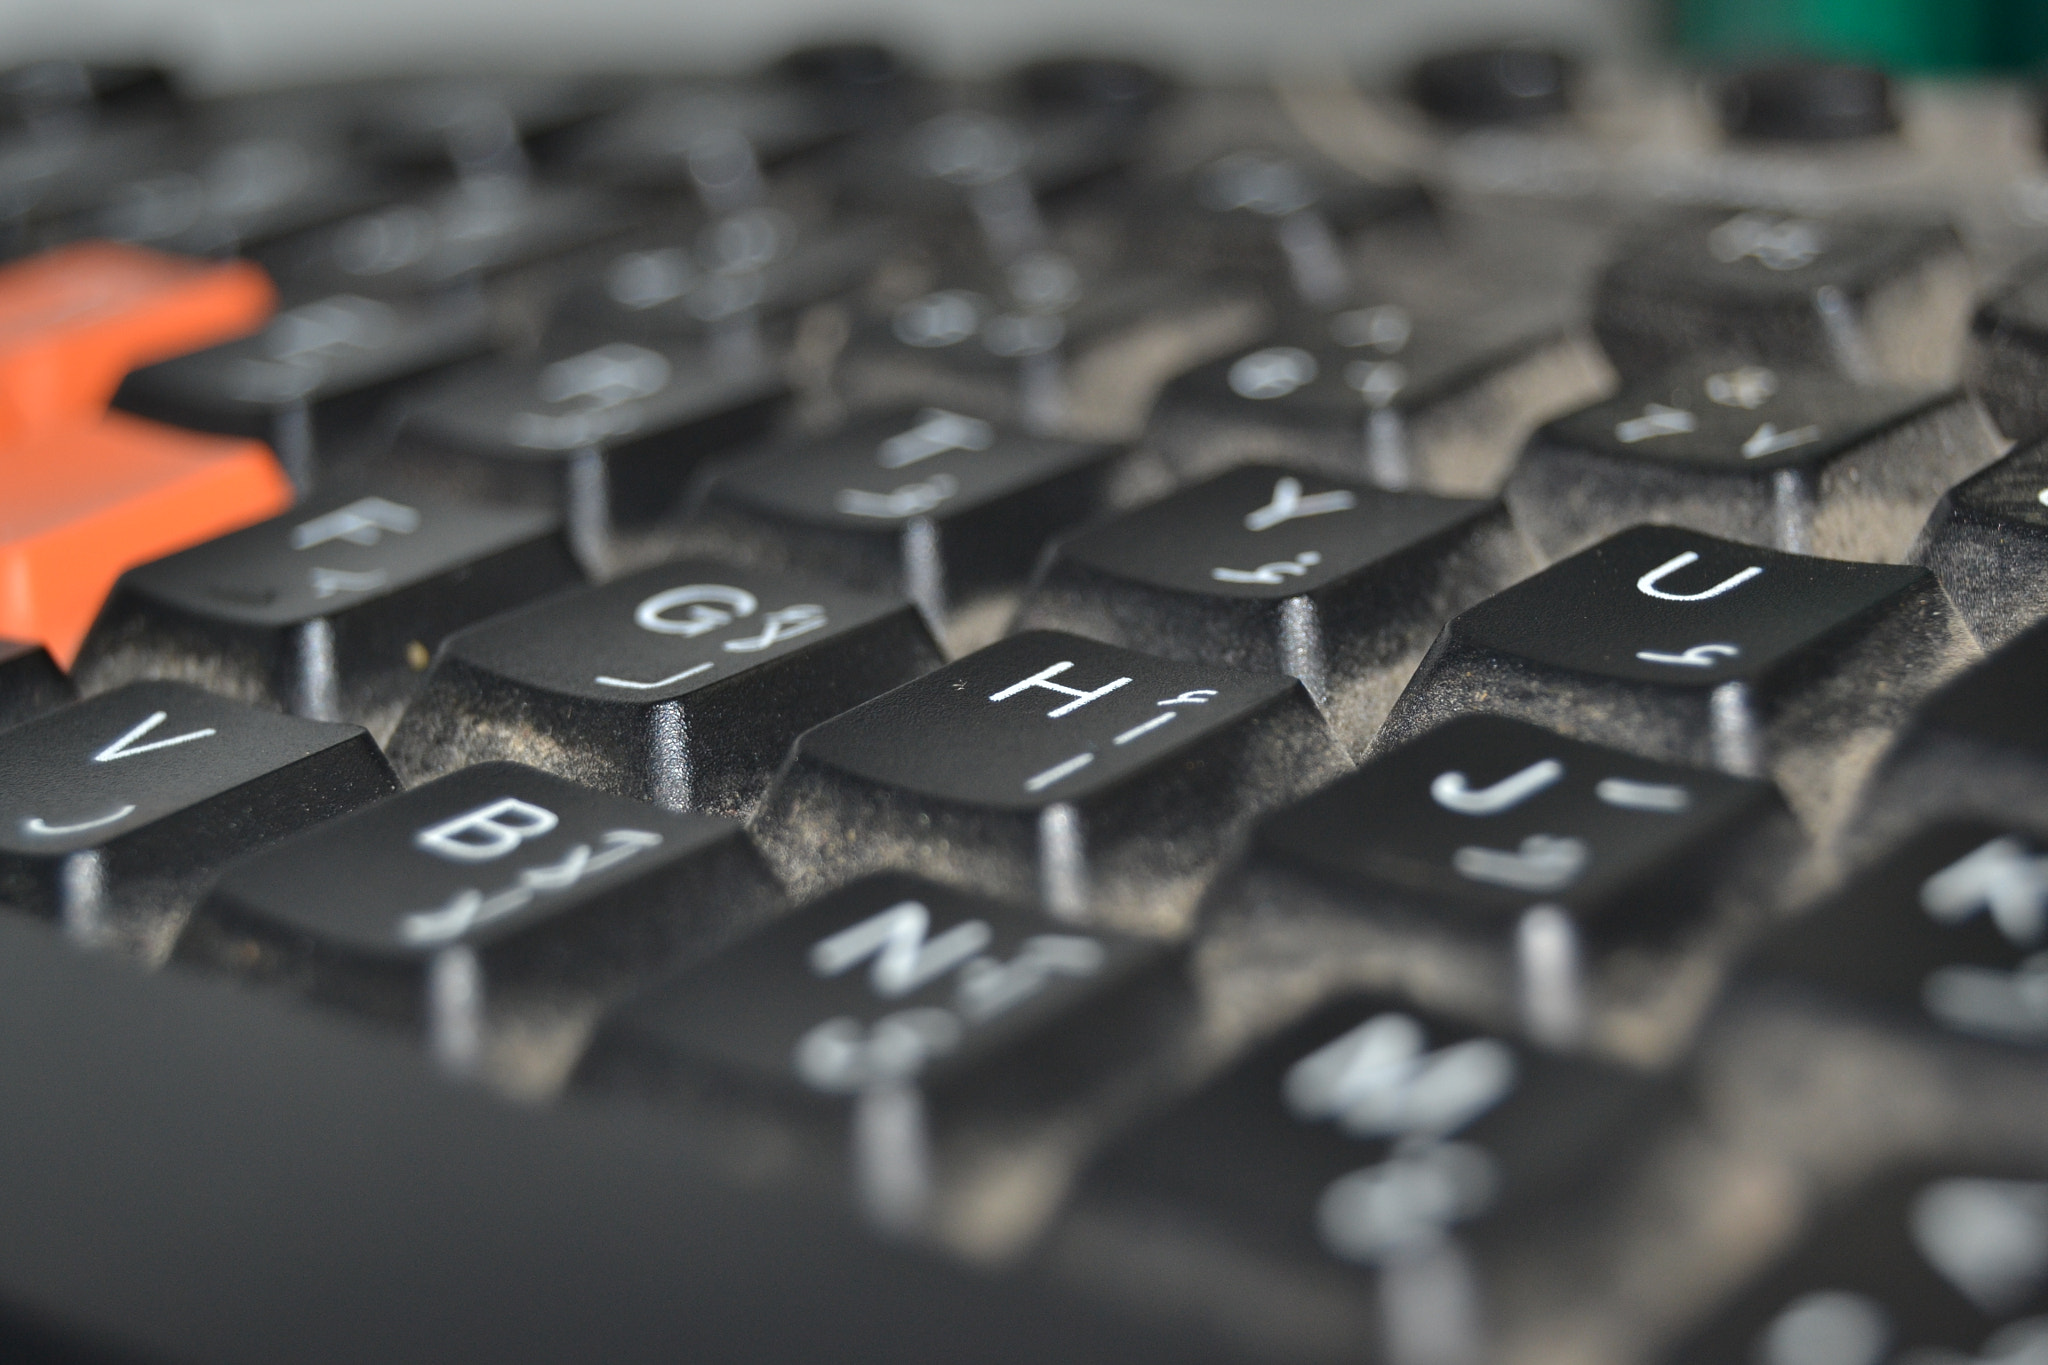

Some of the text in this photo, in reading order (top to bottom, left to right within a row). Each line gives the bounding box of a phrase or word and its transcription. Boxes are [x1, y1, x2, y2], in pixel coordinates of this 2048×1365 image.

[1244, 475, 1357, 532] Y
[1636, 551, 1764, 602] U
[634, 584, 759, 636] G
[988, 660, 1134, 718] H
[91, 710, 217, 763] V
[1430, 757, 1565, 814] J
[414, 796, 561, 862] B
[811, 898, 992, 996] N
